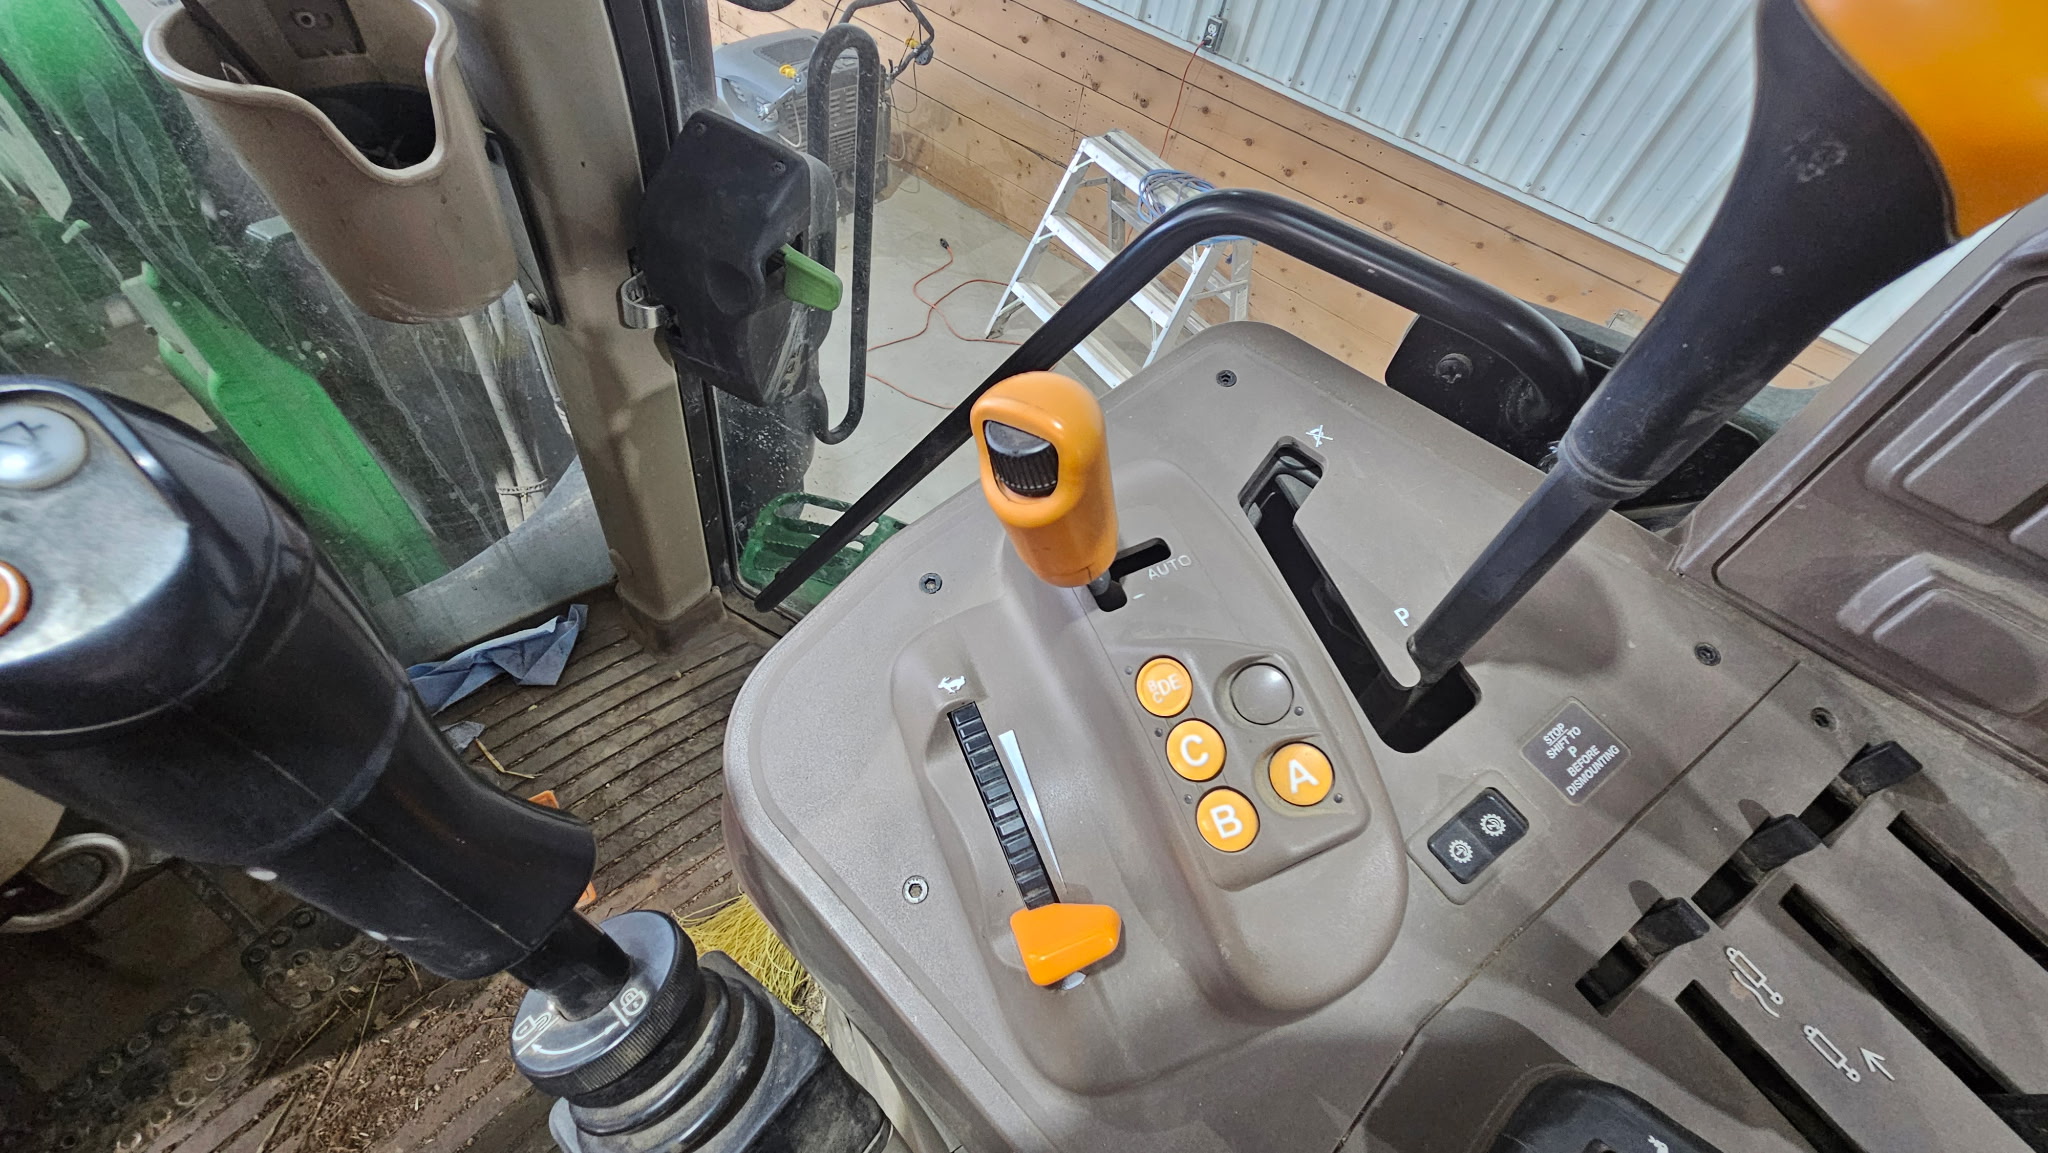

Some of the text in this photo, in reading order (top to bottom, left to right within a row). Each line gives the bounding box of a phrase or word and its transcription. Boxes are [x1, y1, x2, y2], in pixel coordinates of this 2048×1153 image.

[1148, 555, 1192, 581] AUTO
[1394, 607, 1411, 627] P
[1543, 722, 1565, 745] STOP
[1546, 726, 1582, 760] SHIFT TO
[1180, 734, 1209, 767] C
[1566, 744, 1601, 777] BEFORE
[1567, 745, 1578, 758] P
[1289, 759, 1319, 794] A
[1566, 744, 1620, 796] DISMOUNTING
[1210, 805, 1242, 839] B
